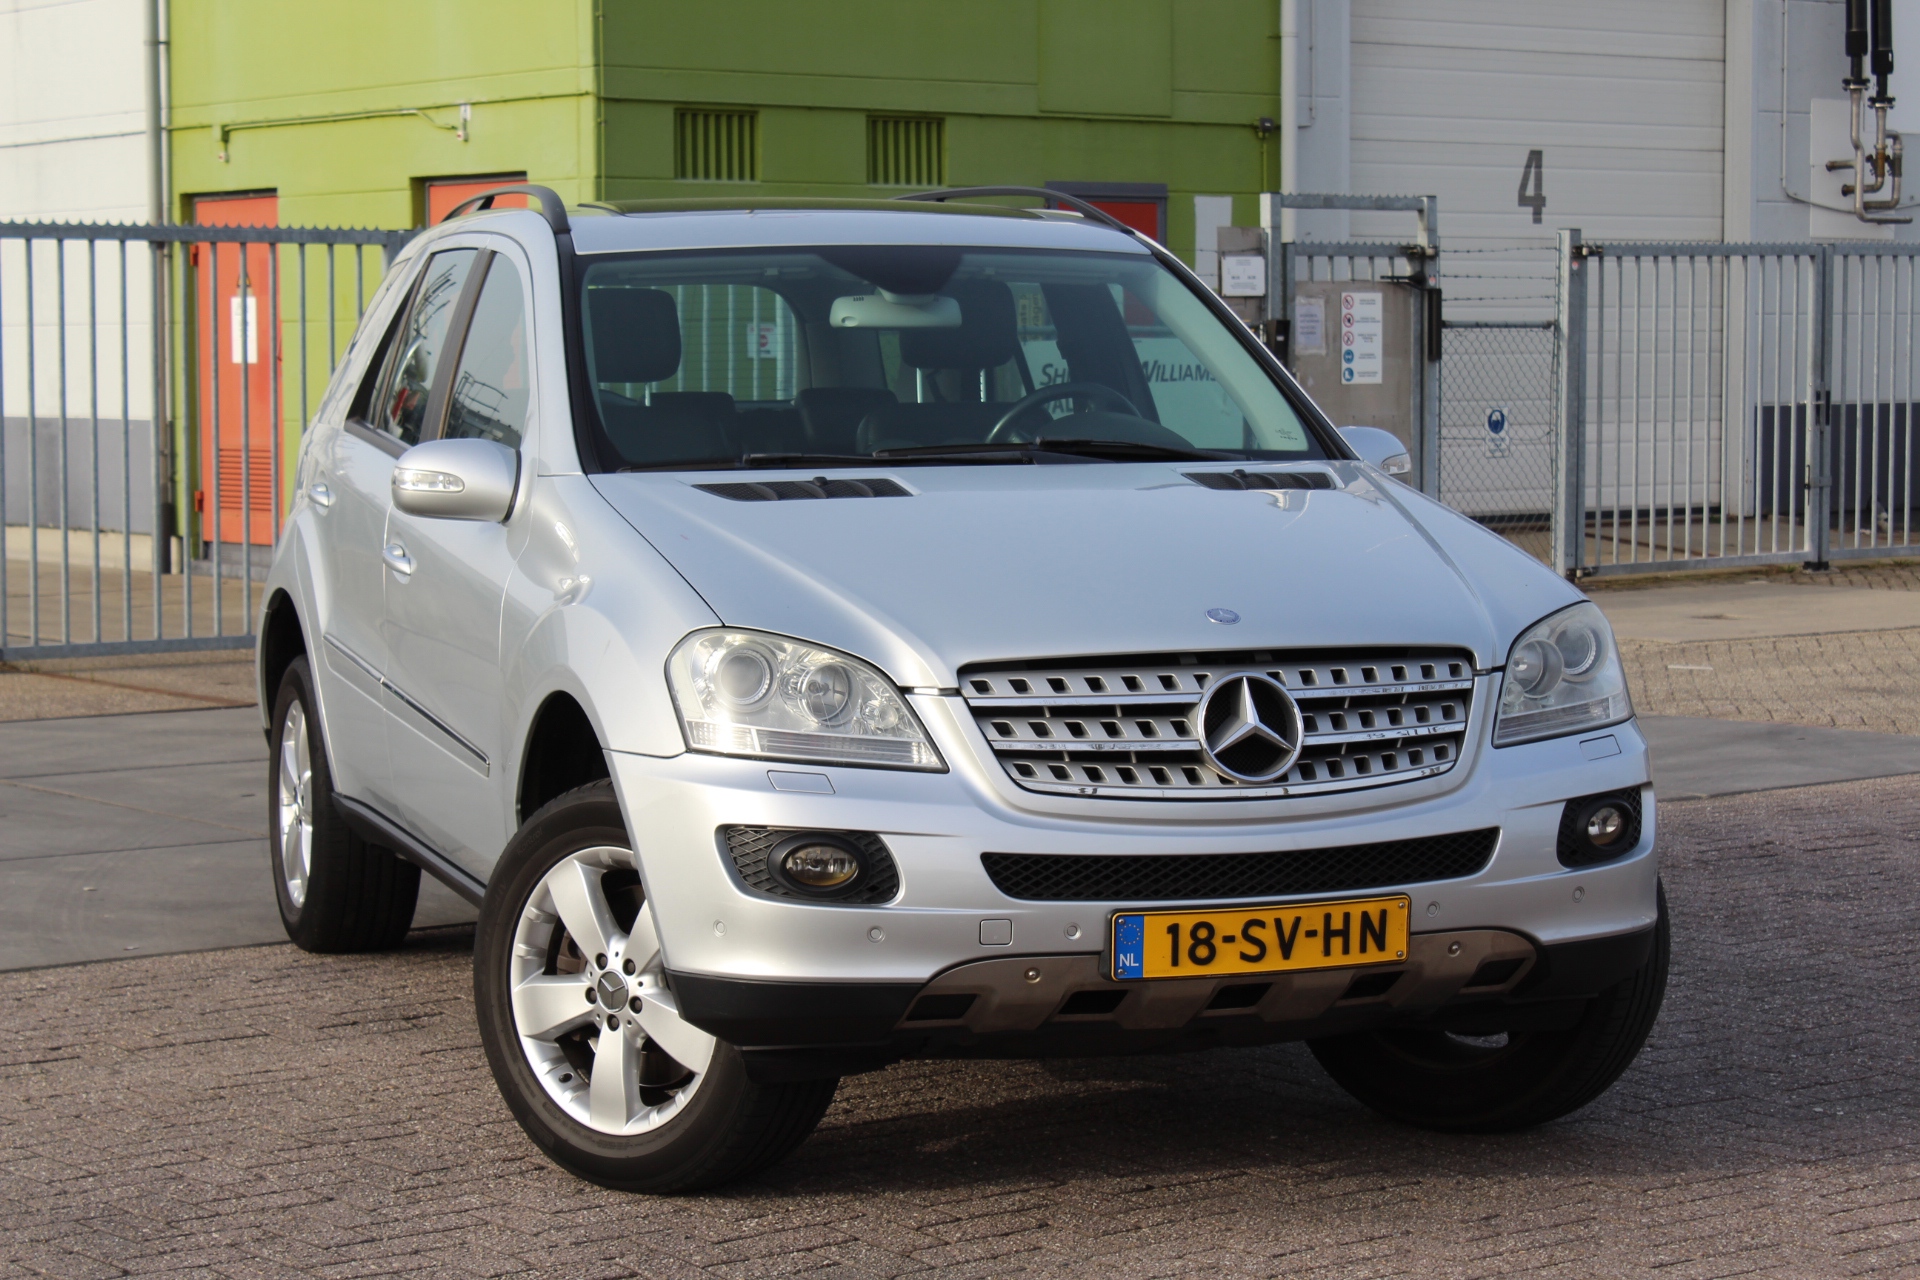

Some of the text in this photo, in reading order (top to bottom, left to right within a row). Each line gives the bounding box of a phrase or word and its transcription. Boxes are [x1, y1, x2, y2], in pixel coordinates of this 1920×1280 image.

[1518, 150, 1547, 224] 4
[1118, 953, 1139, 967] NL
[1167, 909, 1387, 967] 18-SV-HN
